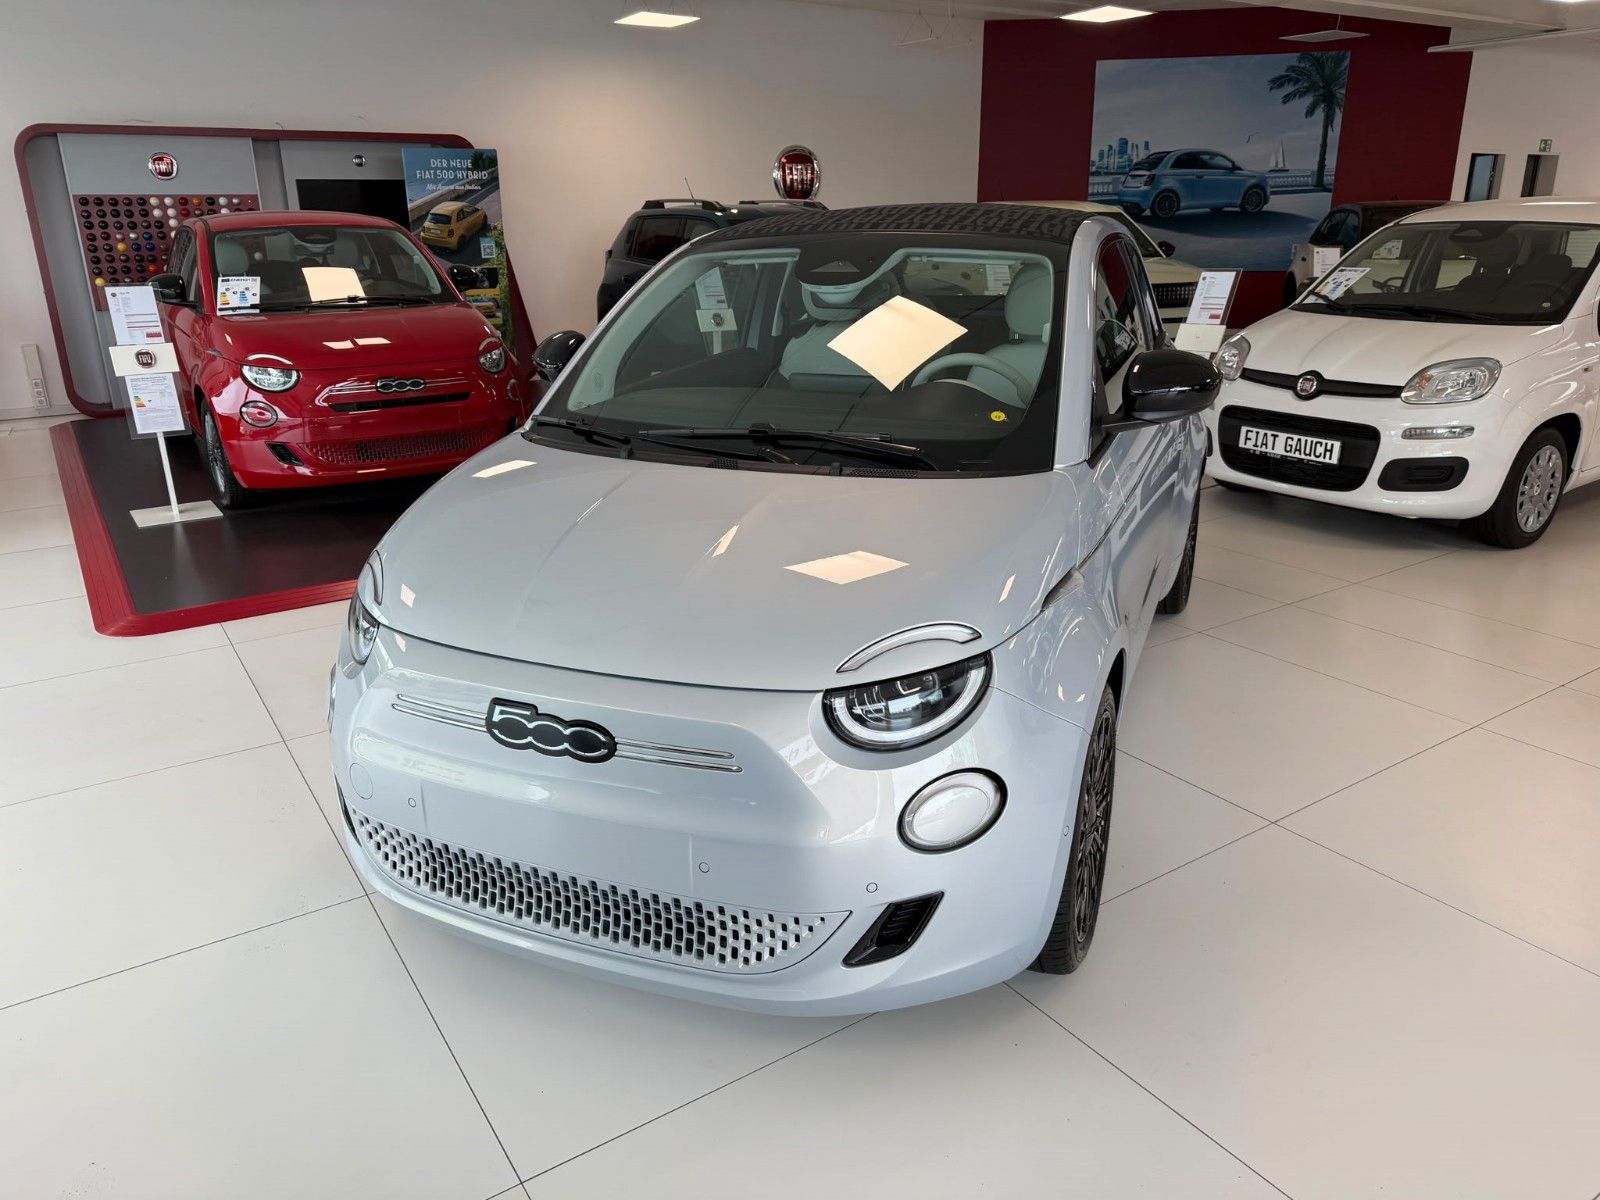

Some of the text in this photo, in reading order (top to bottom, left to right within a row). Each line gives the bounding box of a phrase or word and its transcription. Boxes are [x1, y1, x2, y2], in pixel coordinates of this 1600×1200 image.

[430, 159, 472, 168] DER NEUE
[416, 170, 488, 179] FIAT 500 HYBRID
[377, 378, 425, 392] 500
[1243, 429, 1279, 451] FIAT
[1284, 436, 1334, 461] GAUCH
[490, 703, 610, 757] 500
